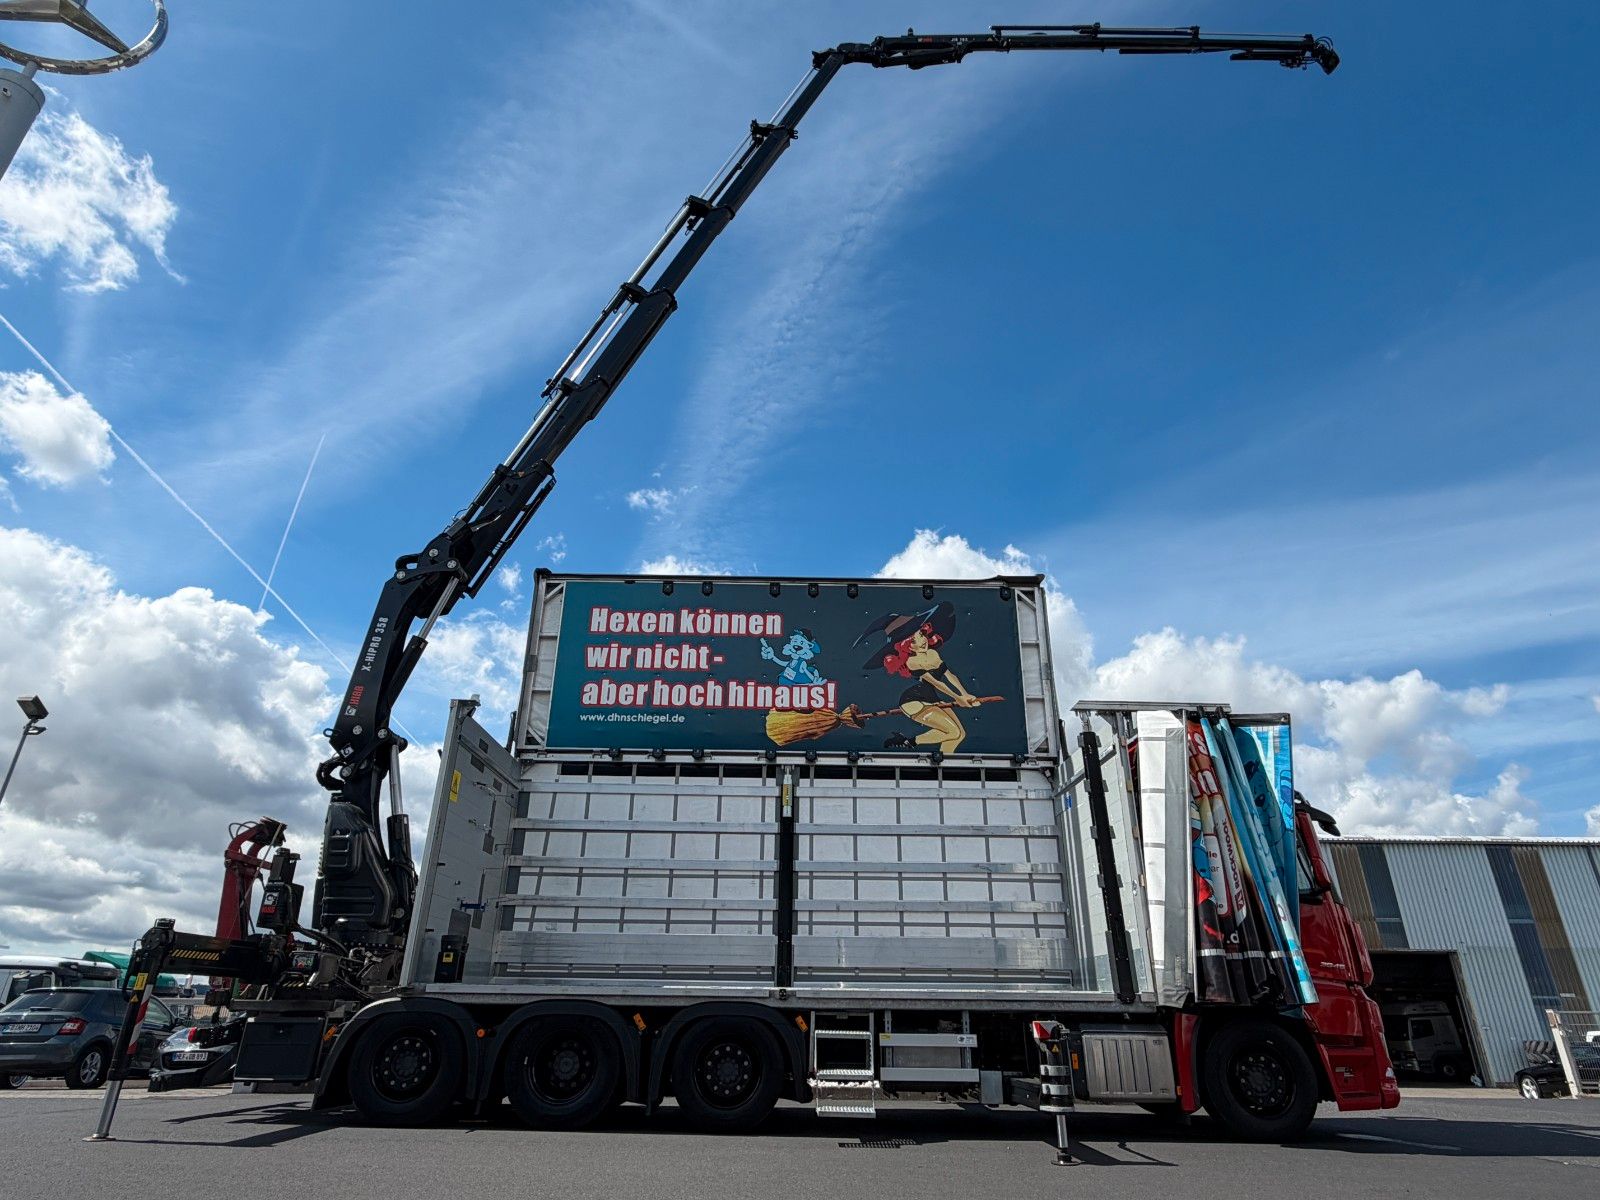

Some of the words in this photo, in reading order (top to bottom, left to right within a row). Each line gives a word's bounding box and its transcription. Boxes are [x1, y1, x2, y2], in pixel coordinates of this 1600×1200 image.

[590, 607, 675, 633] Hexen
[679, 608, 782, 635] können
[361, 636, 382, 672] X-HIPRO
[374, 617, 389, 633] 358
[587, 644, 632, 668] wir
[350, 685, 364, 705] HIAB
[582, 679, 649, 706] aber
[653, 679, 723, 707] hoch
[728, 681, 836, 709] hinaus!
